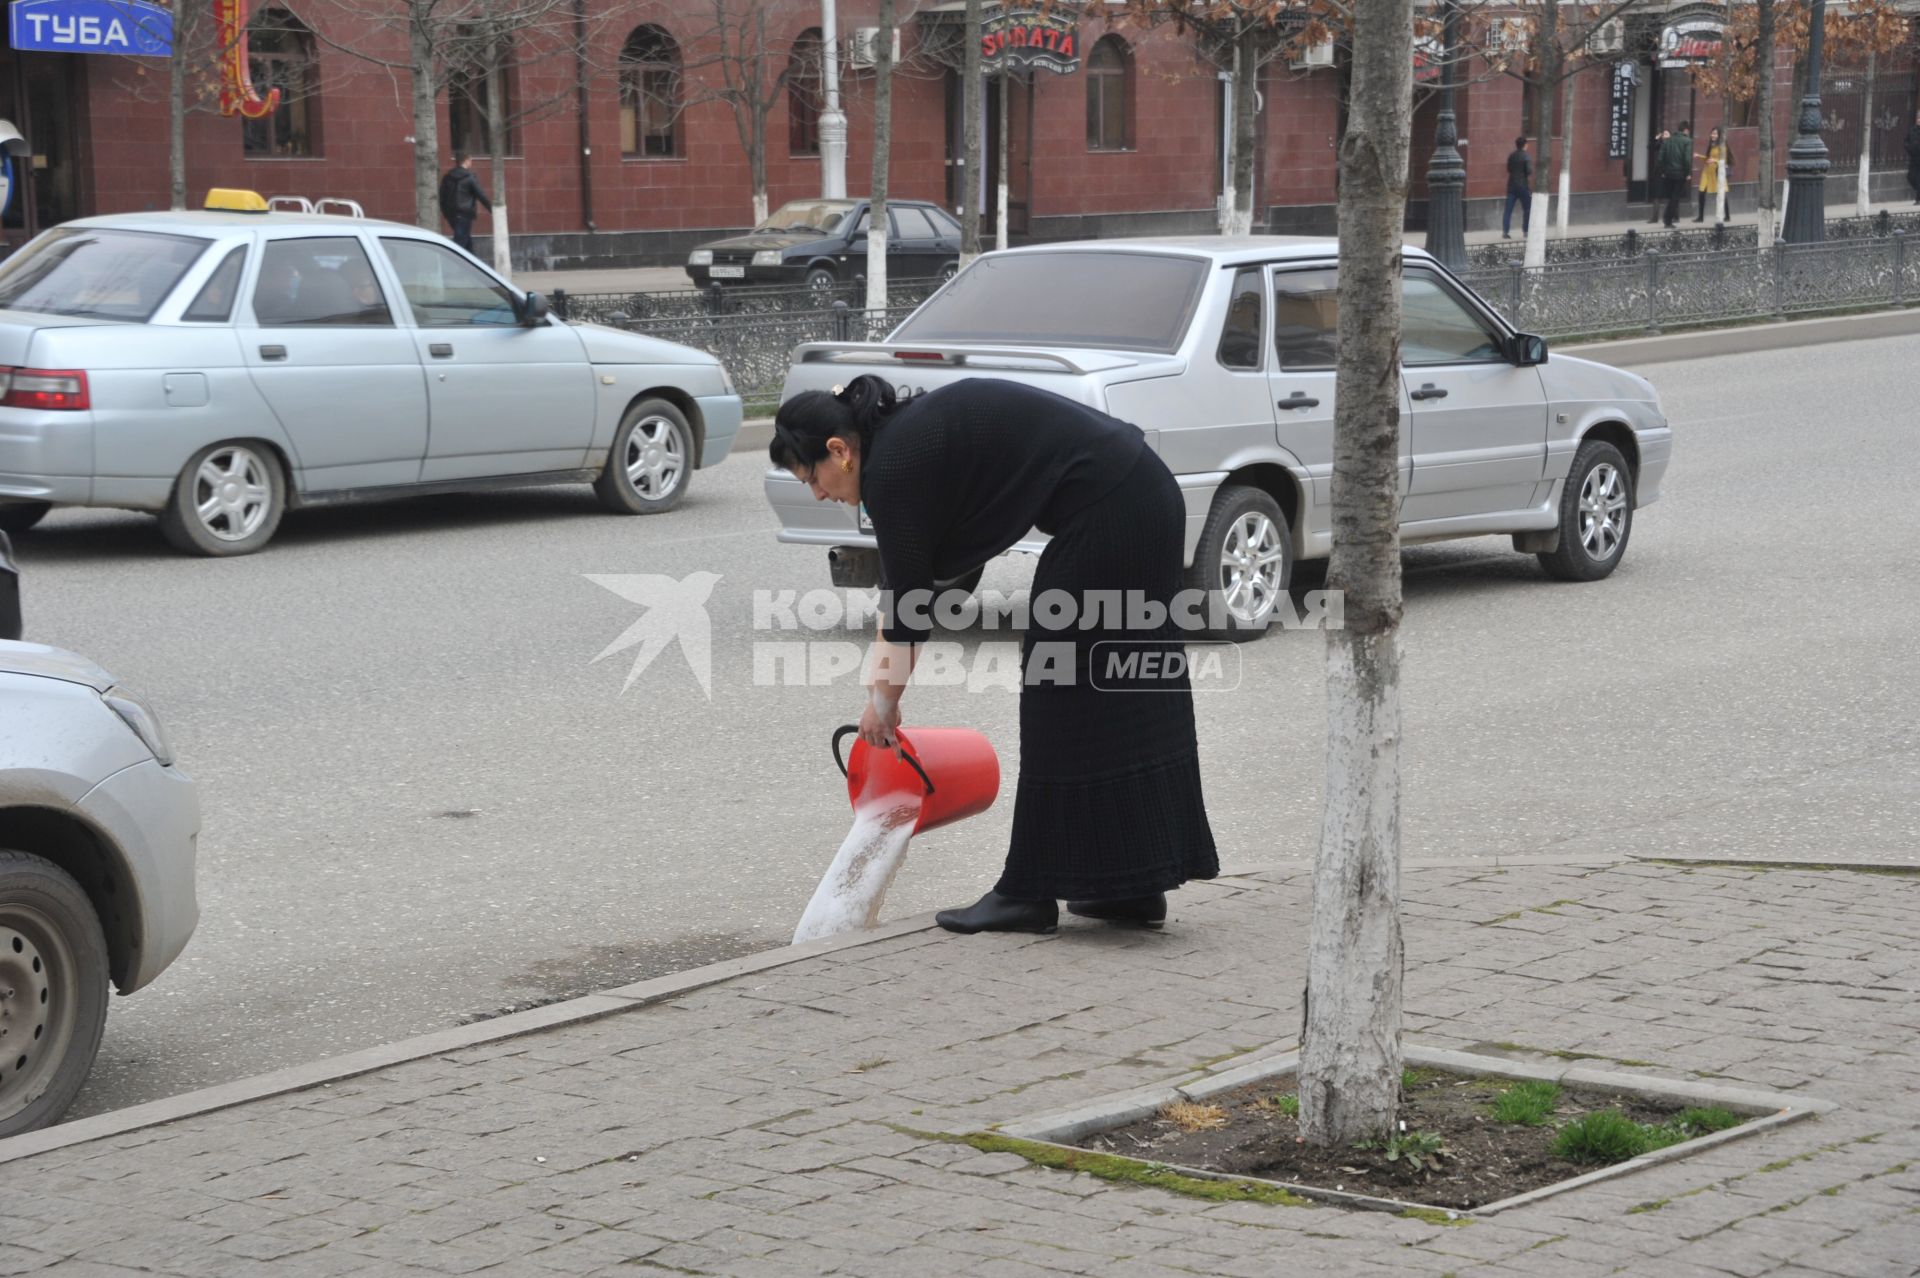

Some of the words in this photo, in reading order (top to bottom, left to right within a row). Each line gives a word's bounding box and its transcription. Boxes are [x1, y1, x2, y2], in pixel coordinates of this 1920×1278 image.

[25, 13, 129, 47] ТУБА
[981, 26, 1074, 57] SONATA
[1610, 106, 1620, 157] КРАСОТЫ
